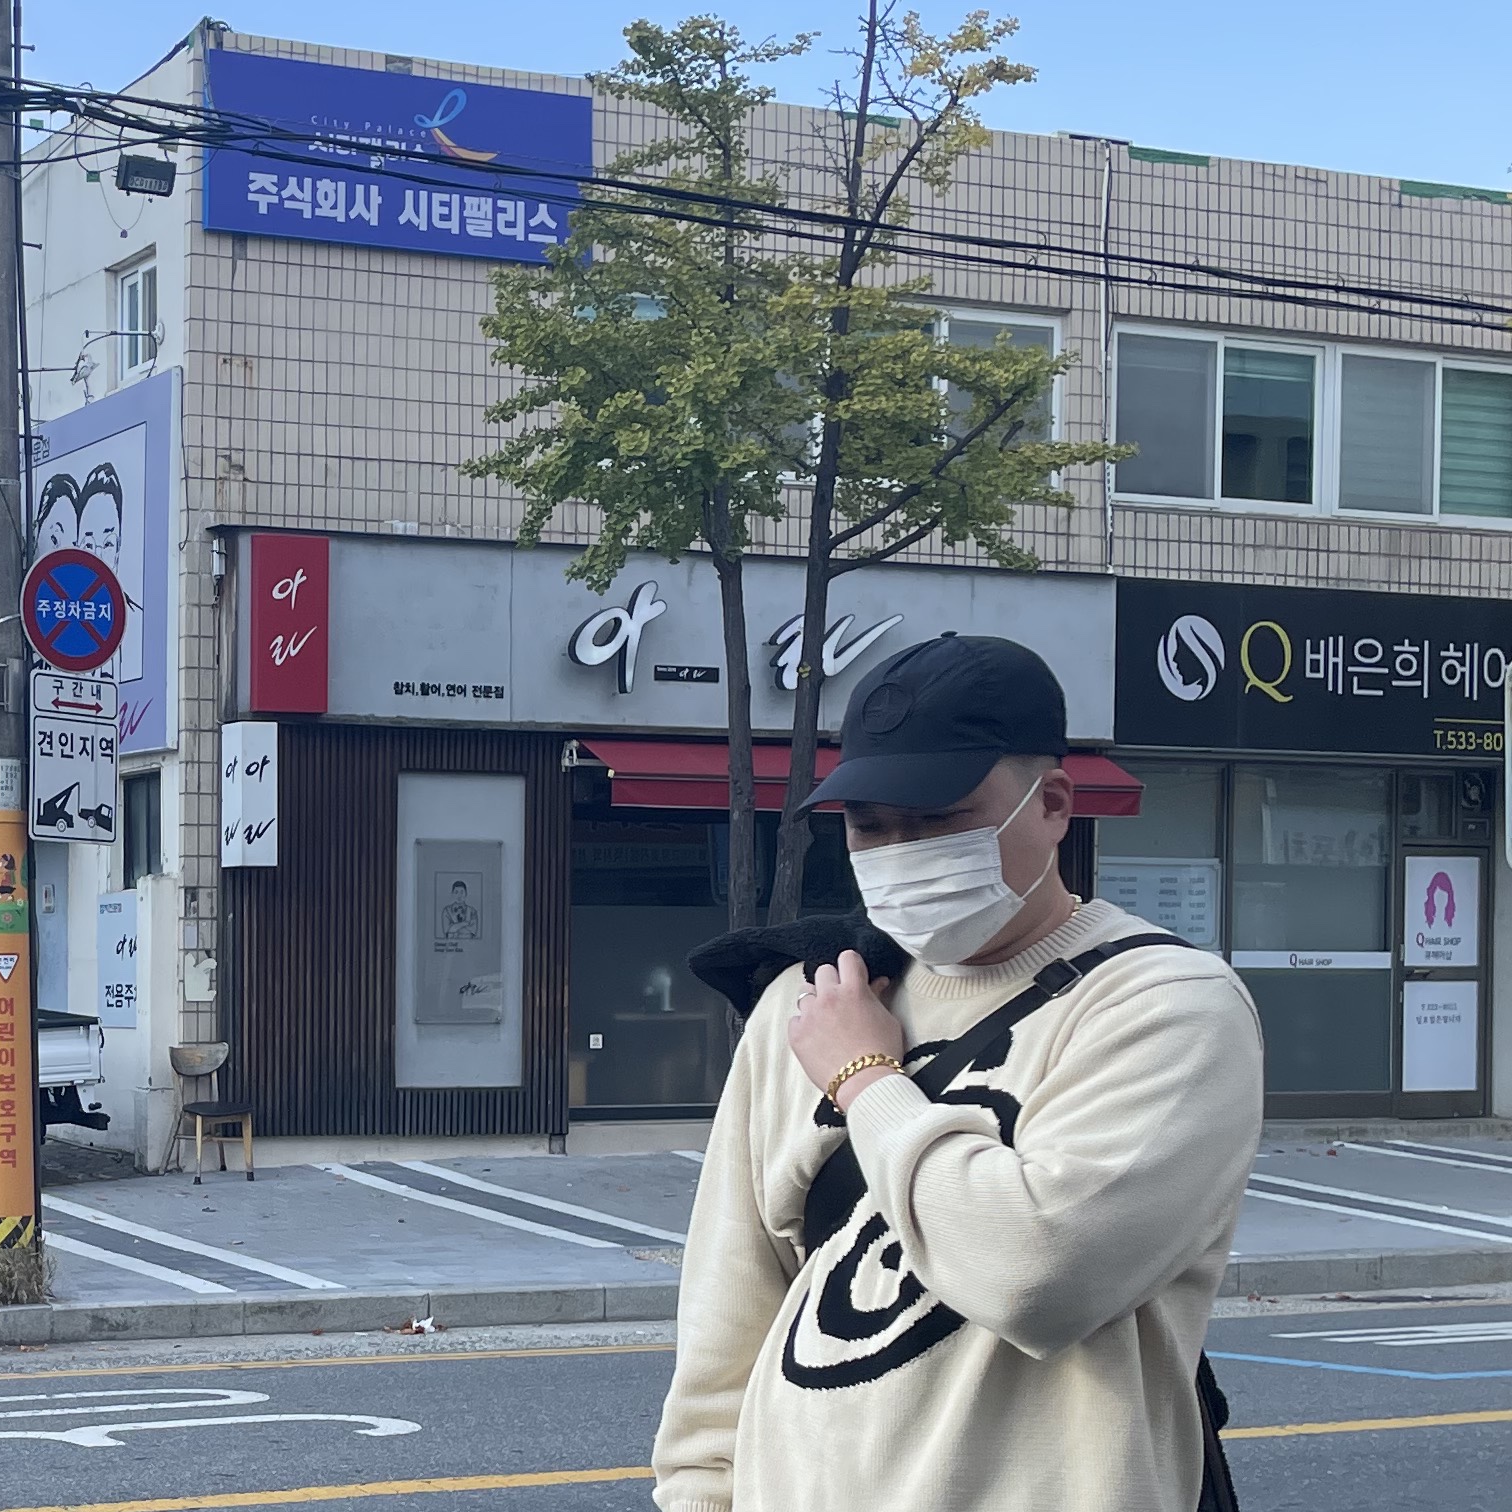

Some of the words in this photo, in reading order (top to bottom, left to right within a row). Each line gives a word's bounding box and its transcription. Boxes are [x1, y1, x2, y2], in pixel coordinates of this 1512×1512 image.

[247, 171, 383, 226] 주식회사
[398, 189, 558, 243] 시티팰리스
[37, 599, 112, 622] 주정차금지
[1304, 635, 1431, 699] 배은희
[37, 730, 114, 765] 견인지역
